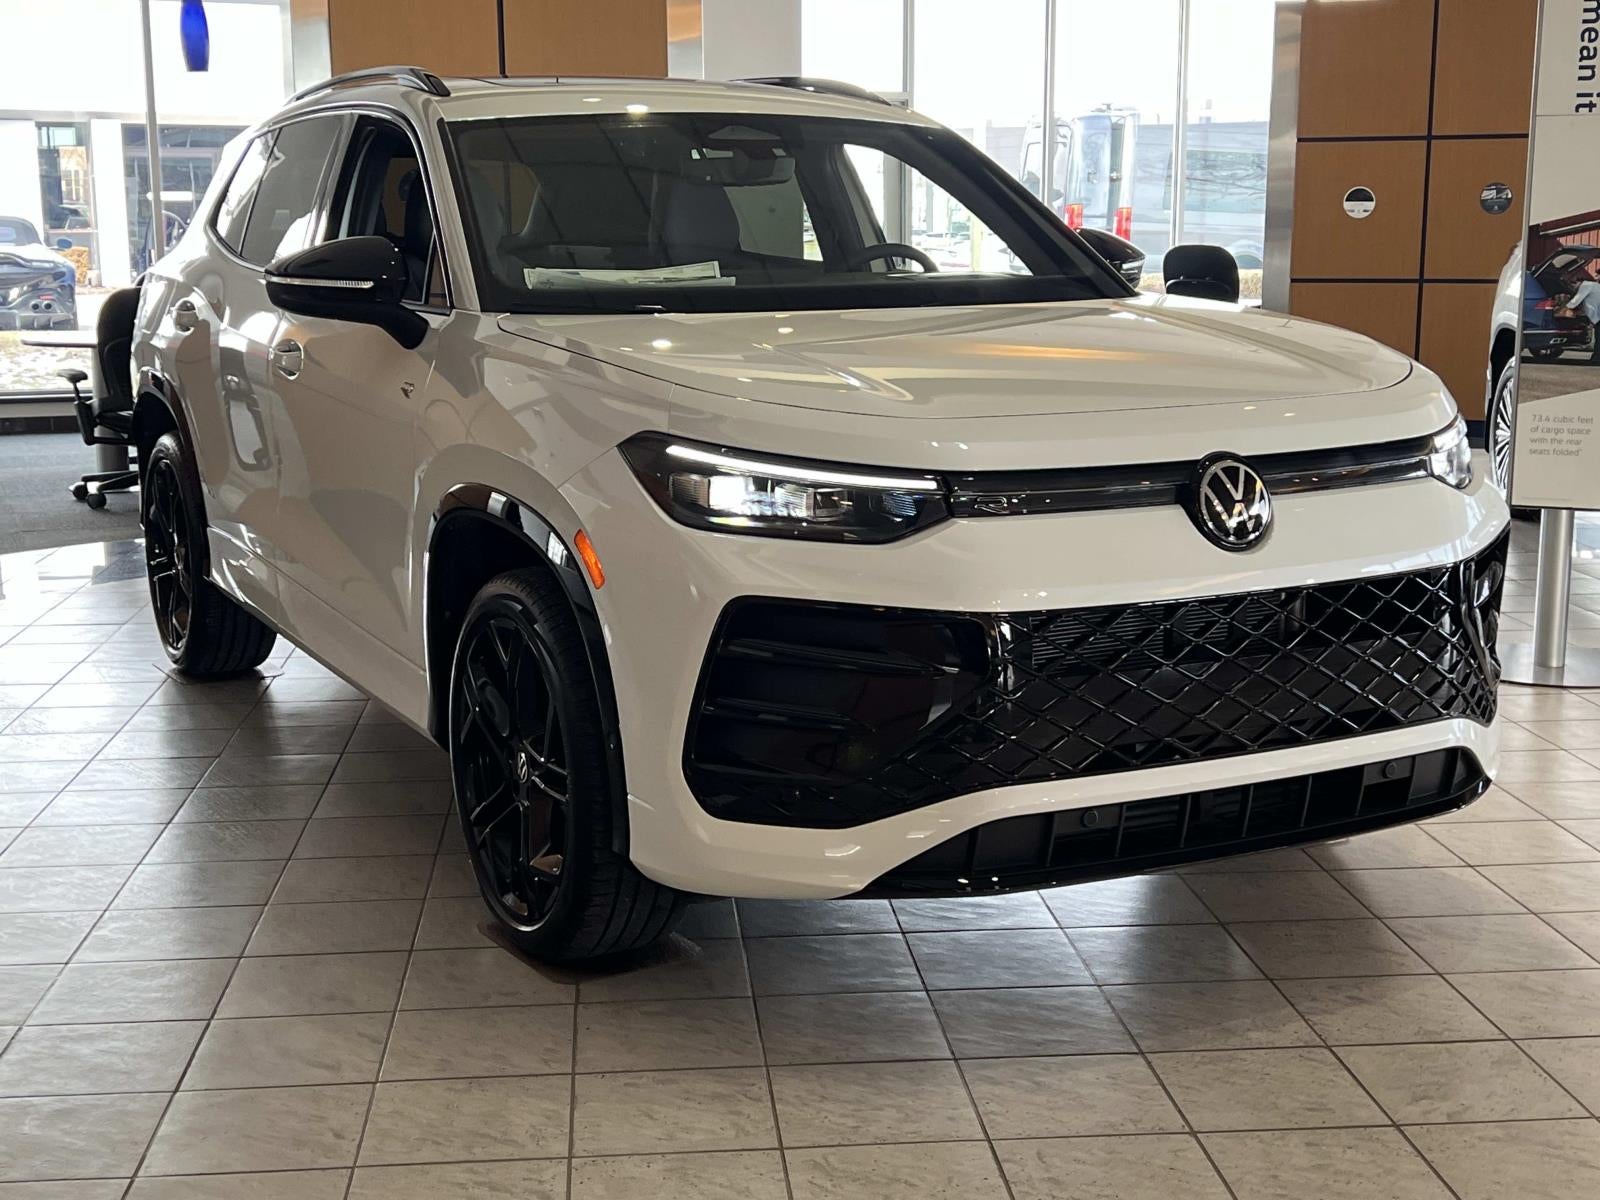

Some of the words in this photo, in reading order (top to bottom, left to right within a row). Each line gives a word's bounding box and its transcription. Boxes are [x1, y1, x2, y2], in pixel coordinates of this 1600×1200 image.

[1575, 92, 1600, 113] it
[1552, 416, 1575, 424] cubic
[1577, 416, 1594, 424] feet
[1541, 427, 1565, 436] cargo
[1567, 428, 1591, 436] space
[1529, 448, 1550, 456] seats
